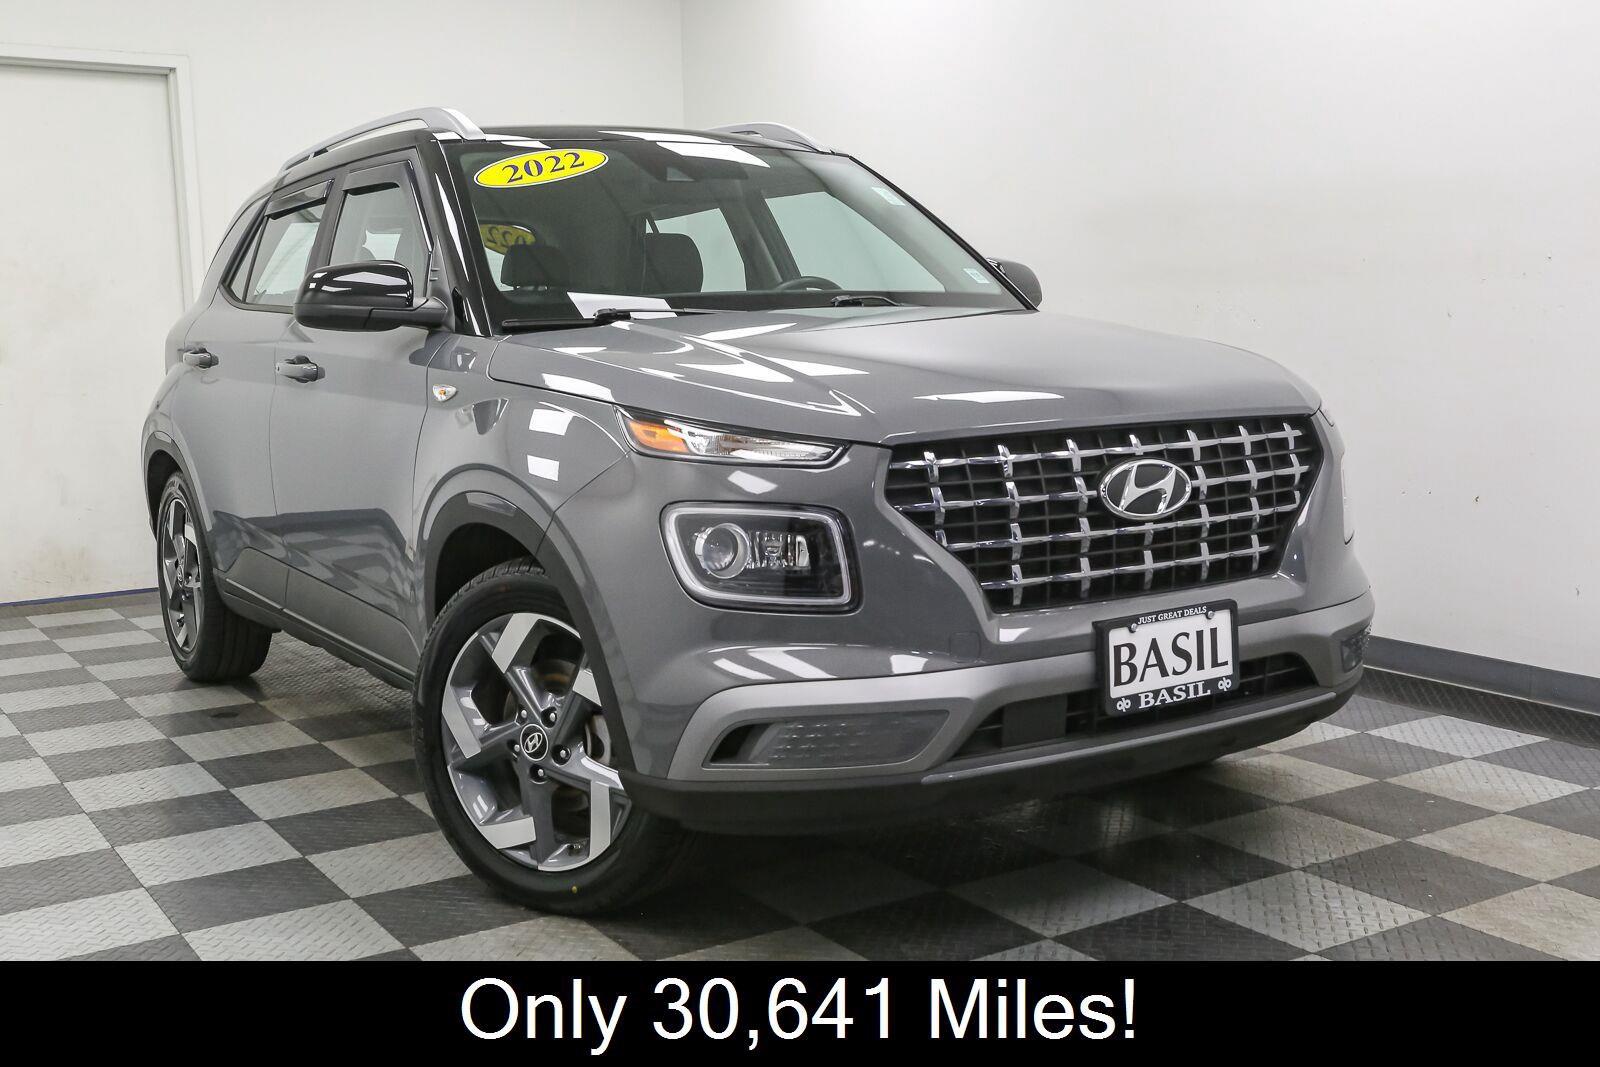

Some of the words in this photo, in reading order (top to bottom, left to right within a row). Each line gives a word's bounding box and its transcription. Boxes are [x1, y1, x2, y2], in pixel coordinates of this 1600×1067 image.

[502, 152, 584, 184] 2022
[1137, 614, 1157, 625] JUST
[1158, 610, 1183, 621] GREAT
[1184, 605, 1207, 617] DEALS
[1113, 627, 1229, 687] BASIL
[1138, 681, 1211, 709] BASIL
